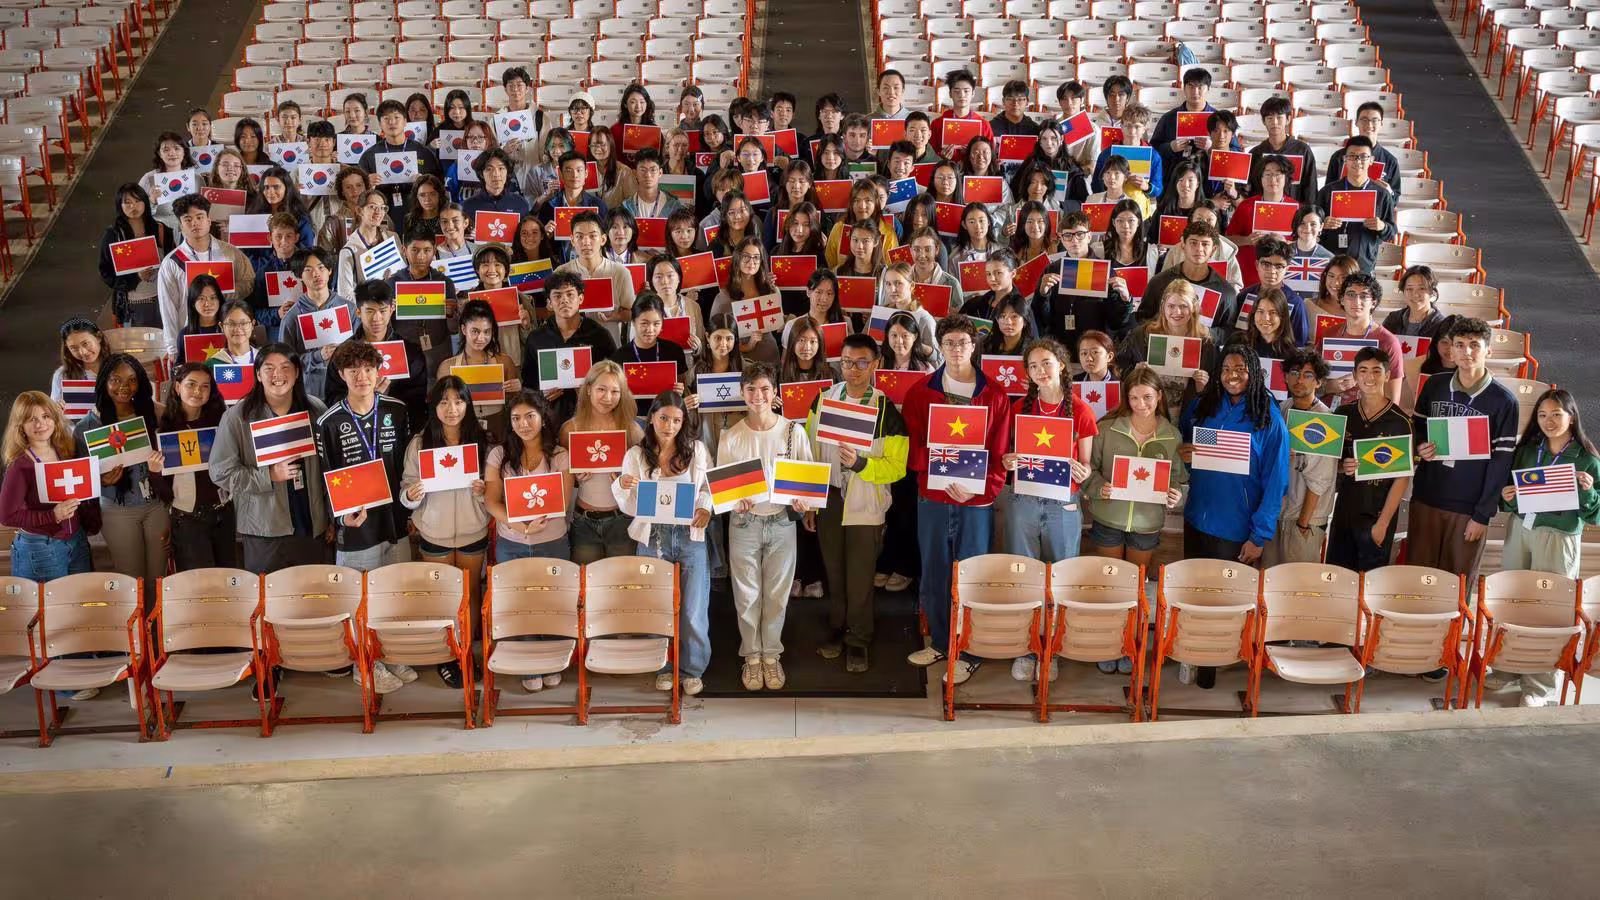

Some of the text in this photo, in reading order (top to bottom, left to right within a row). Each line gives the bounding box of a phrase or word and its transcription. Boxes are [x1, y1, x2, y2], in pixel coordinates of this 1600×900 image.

[552, 566, 557, 576] 6
[644, 565, 650, 574] 7
[1108, 565, 1113, 575] 2
[1227, 569, 1233, 578] 3
[333, 573, 339, 582] 4
[434, 570, 440, 581] 5
[1326, 572, 1332, 581] 4
[1426, 575, 1432, 585] 5
[109, 581, 114, 591] 2
[231, 576, 237, 586] 3
[1542, 579, 1548, 589] 6
